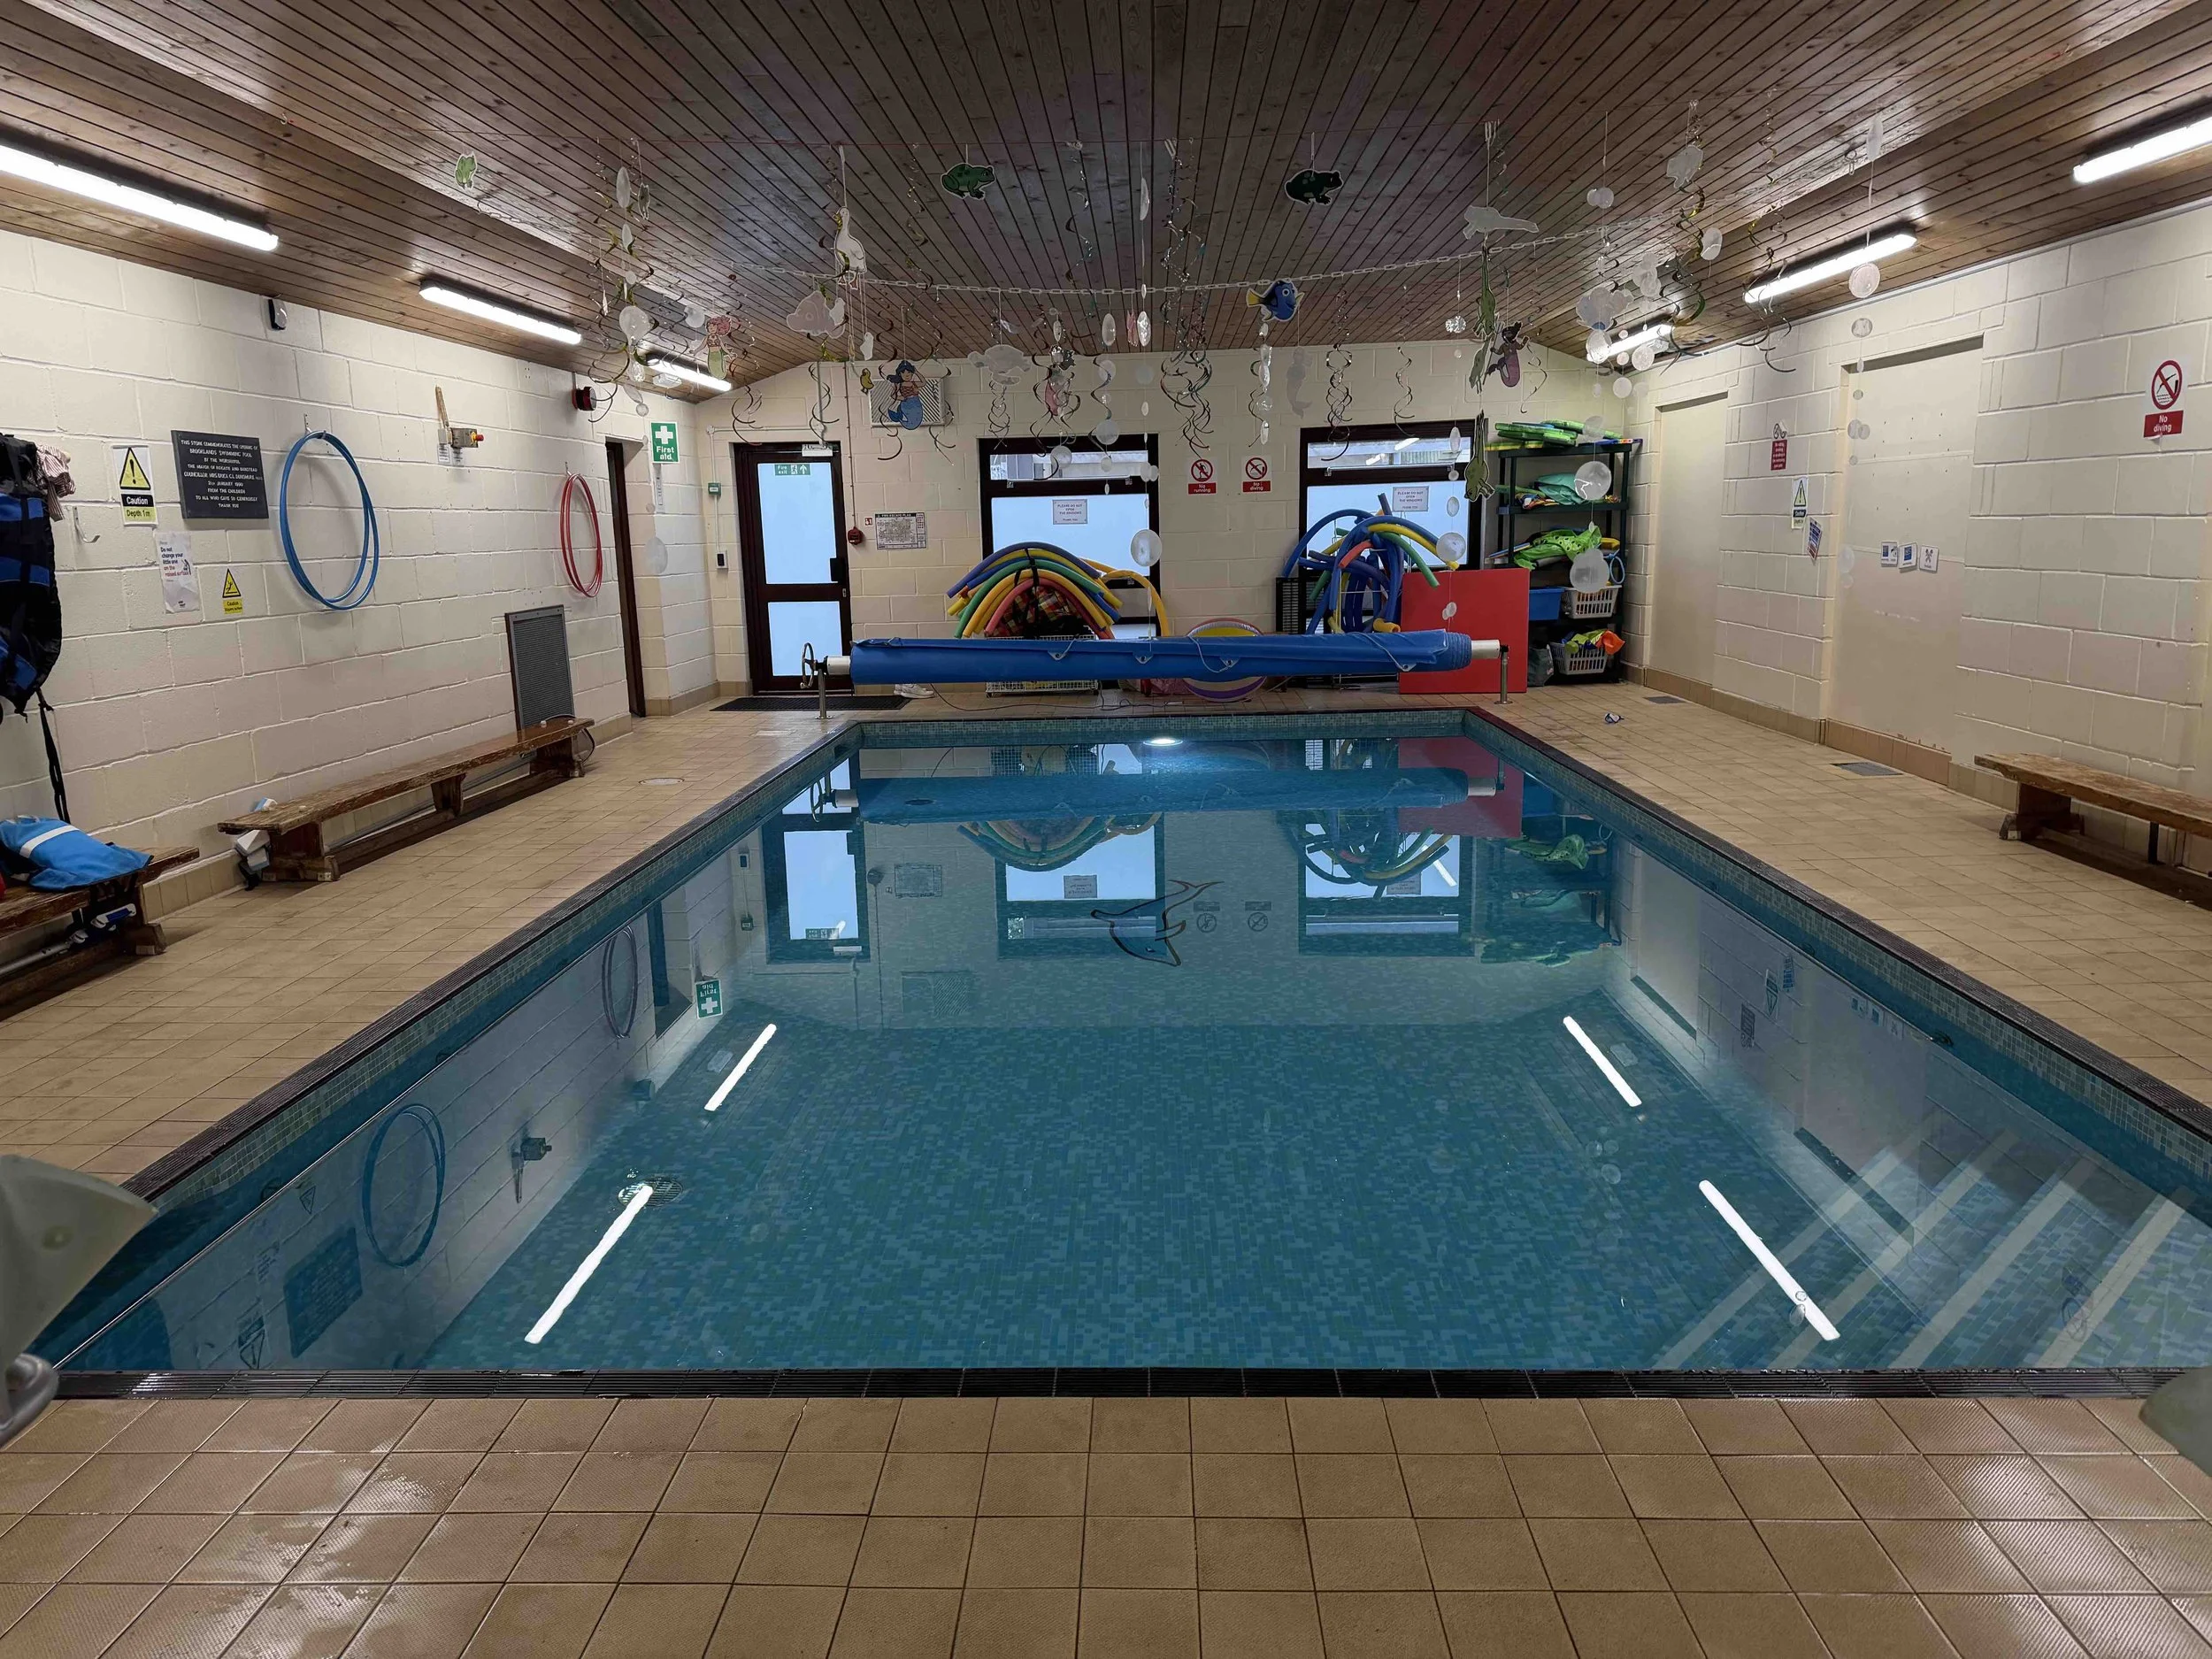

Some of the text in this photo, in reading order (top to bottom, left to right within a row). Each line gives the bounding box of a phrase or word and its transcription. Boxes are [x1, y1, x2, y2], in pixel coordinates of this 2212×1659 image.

[2153, 423, 2172, 433] diving
[126, 496, 148, 505] Caution
[126, 509, 142, 518] Depth
